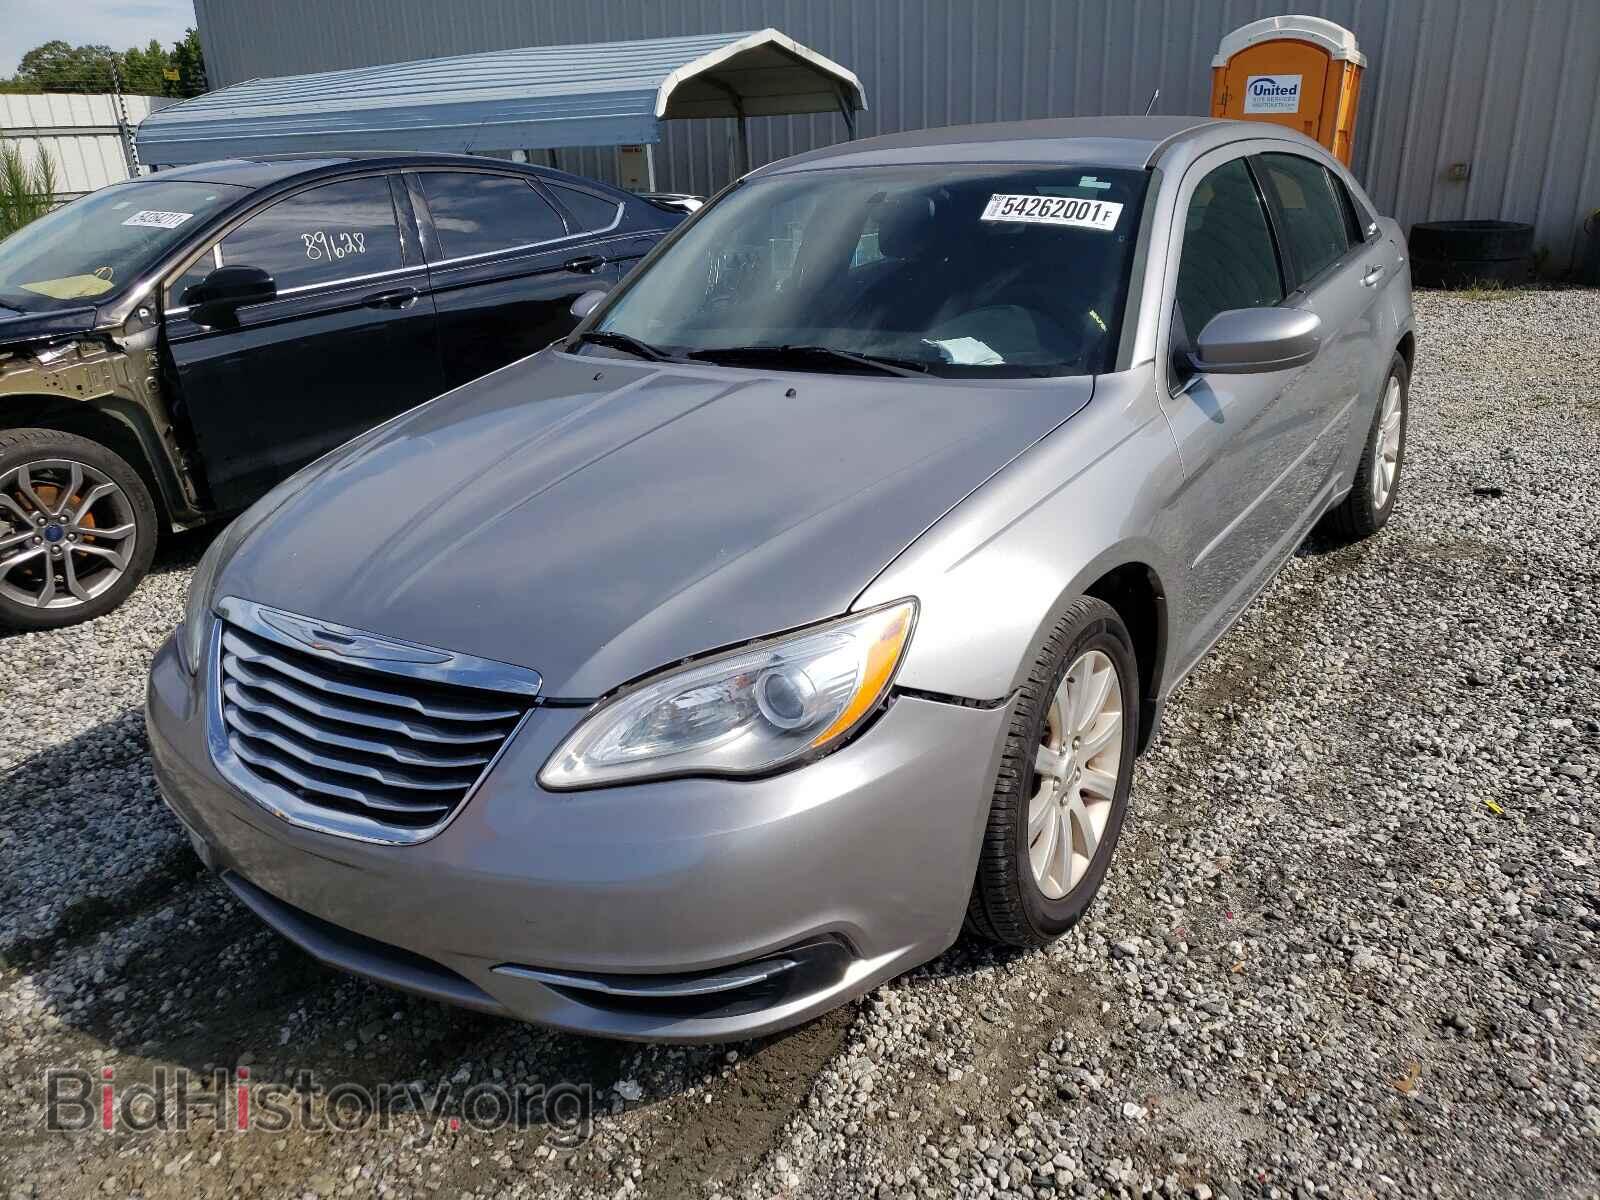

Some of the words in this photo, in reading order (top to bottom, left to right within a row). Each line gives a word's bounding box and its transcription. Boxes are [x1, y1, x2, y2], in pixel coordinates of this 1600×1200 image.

[1253, 83, 1298, 96] United
[1001, 197, 1103, 222] 54262001
[1102, 210, 1113, 222] F
[300, 231, 366, 262] 89628
